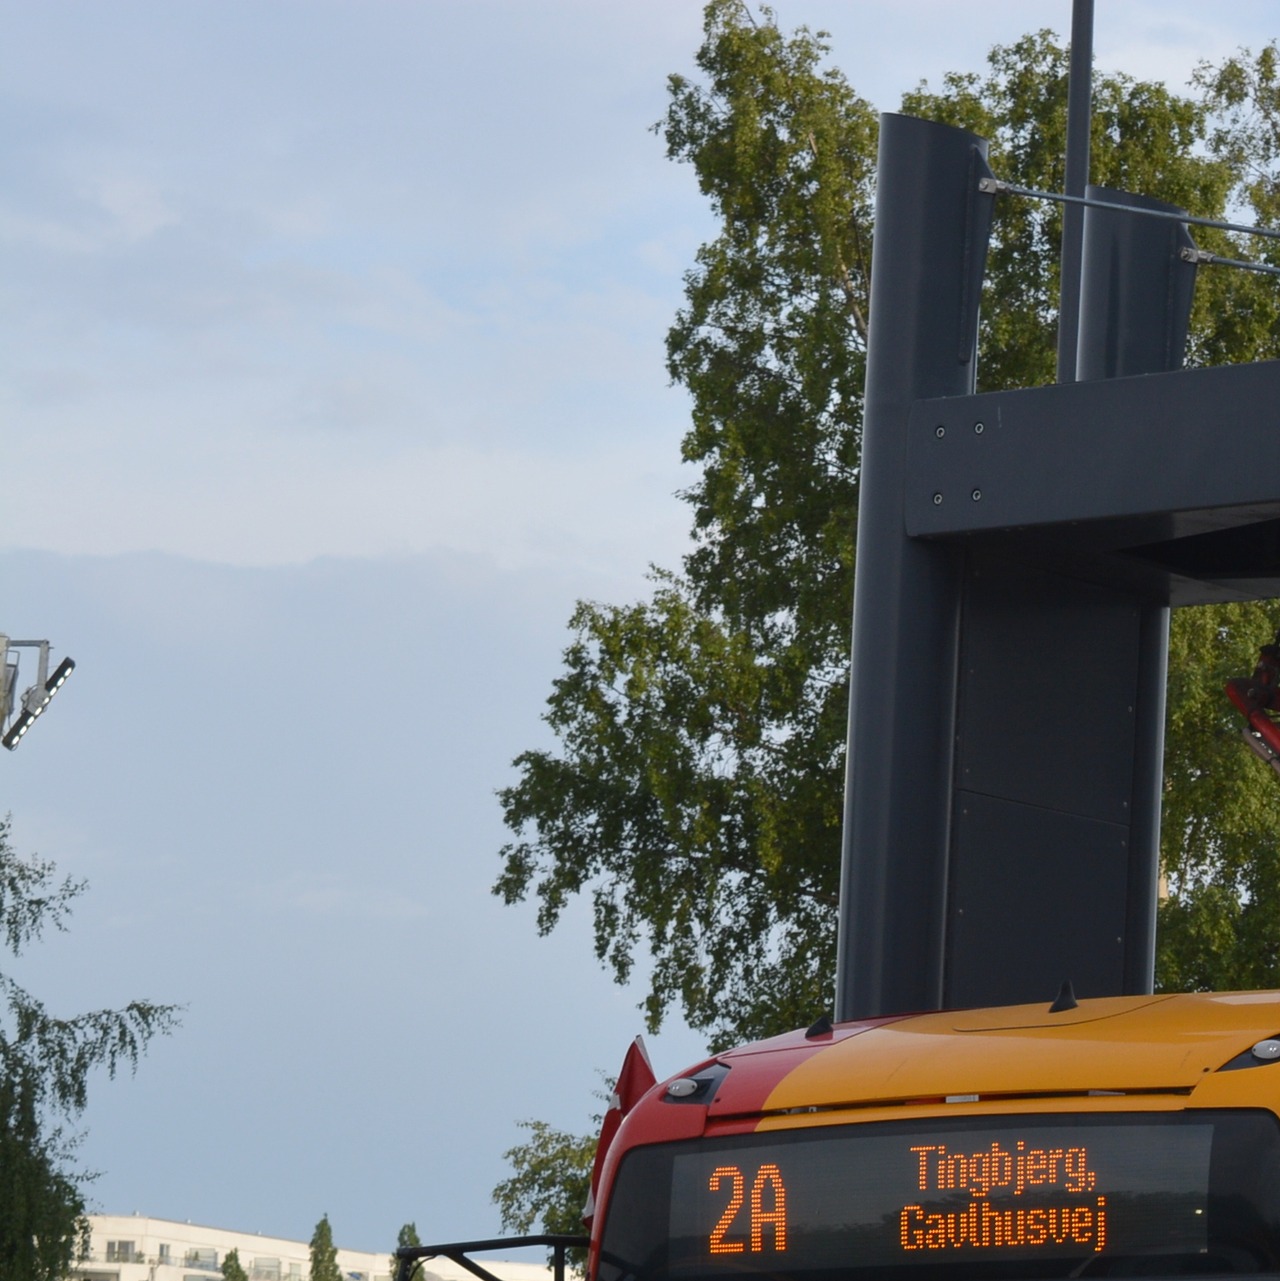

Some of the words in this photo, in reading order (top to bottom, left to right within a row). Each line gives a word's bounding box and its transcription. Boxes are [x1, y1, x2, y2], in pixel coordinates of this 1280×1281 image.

[910, 1141, 1096, 1197] Tingbjerg,
[709, 1163, 787, 1254] 2A
[899, 1196, 1106, 1252] Gavlhusvej
